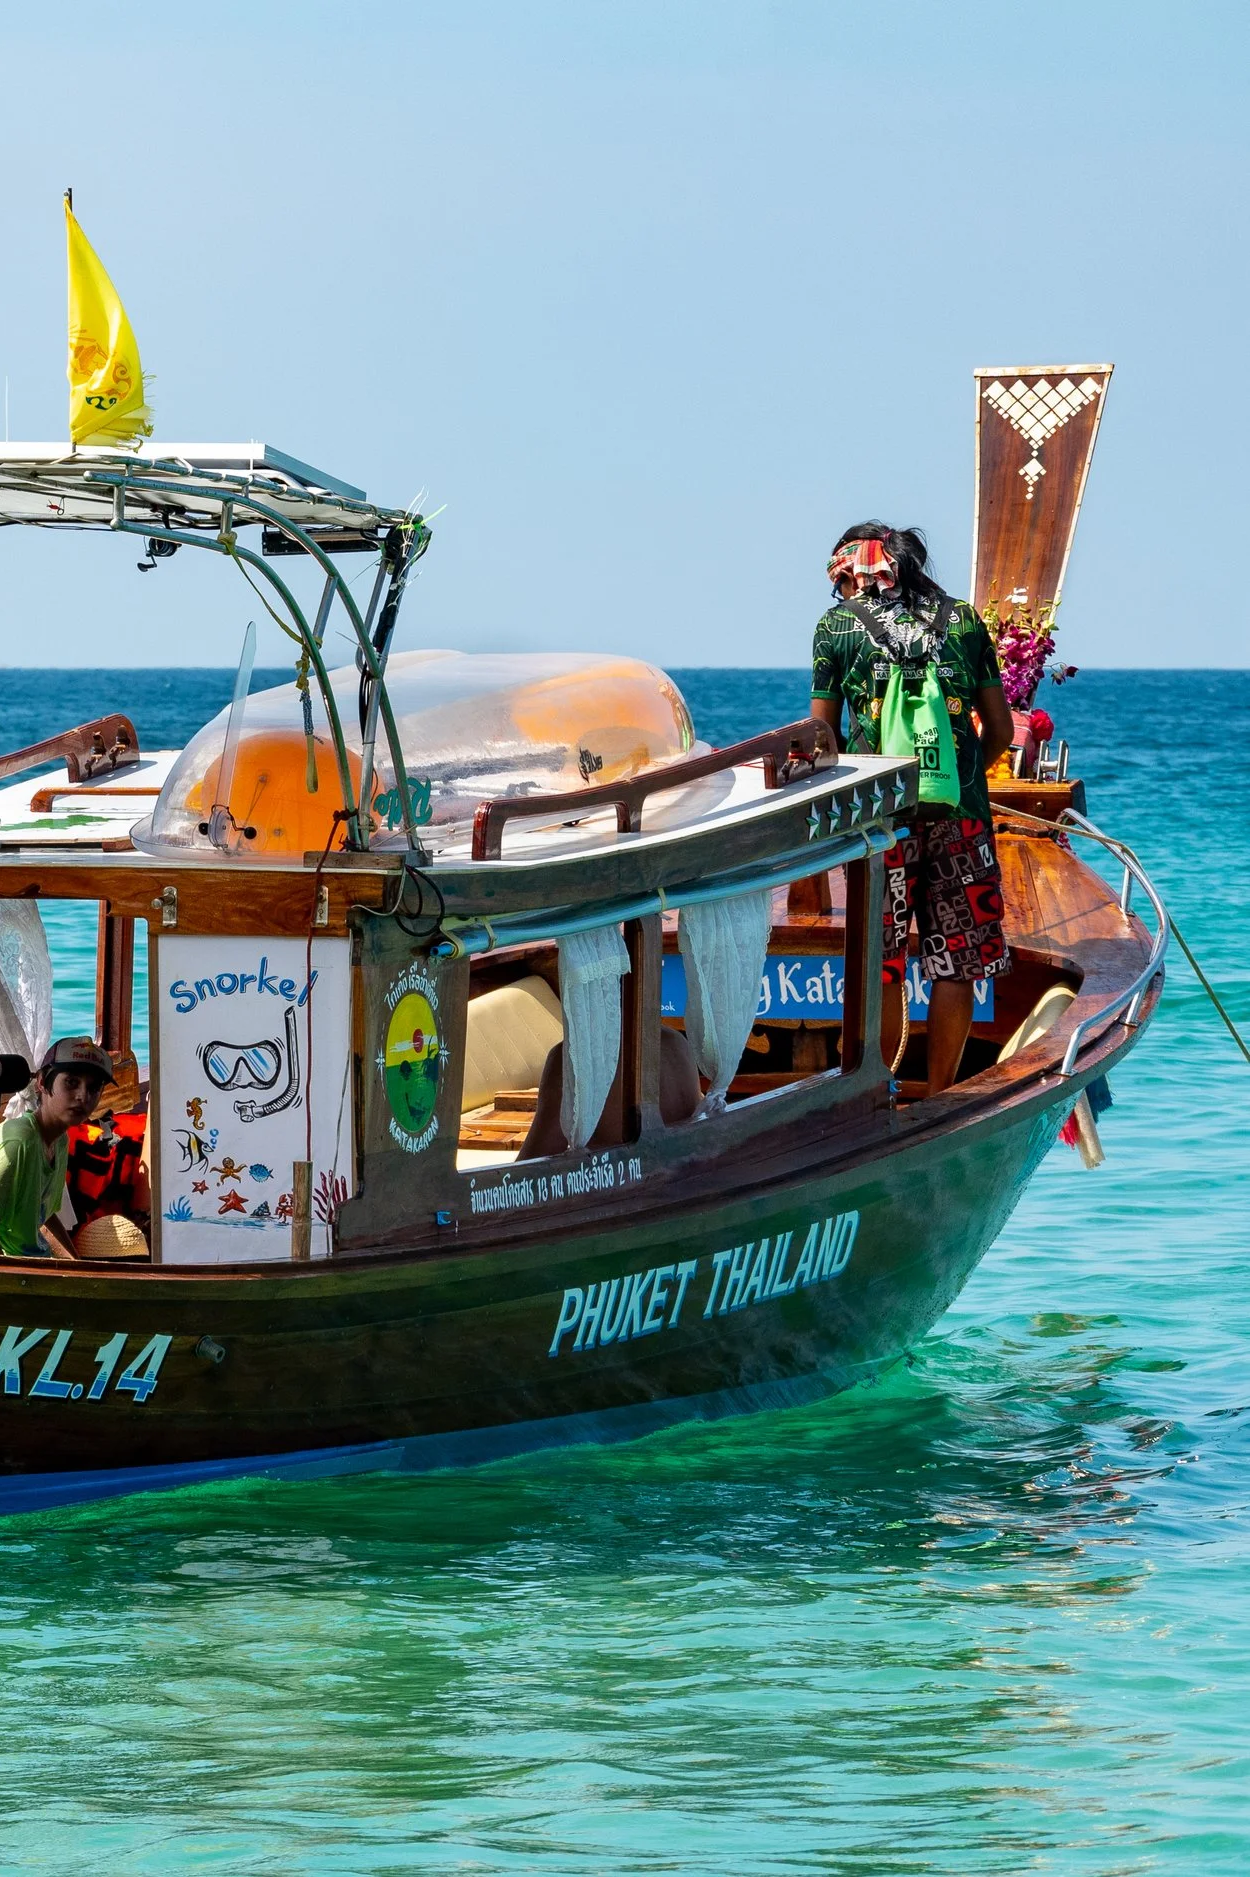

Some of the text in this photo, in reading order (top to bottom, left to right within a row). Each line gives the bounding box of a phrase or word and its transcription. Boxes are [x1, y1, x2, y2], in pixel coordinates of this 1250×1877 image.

[918, 748, 938, 769] 10
[169, 956, 319, 1014] Snorkel
[617, 1160, 626, 1186] 2
[548, 1210, 860, 1358] PHUKET THAILAND
